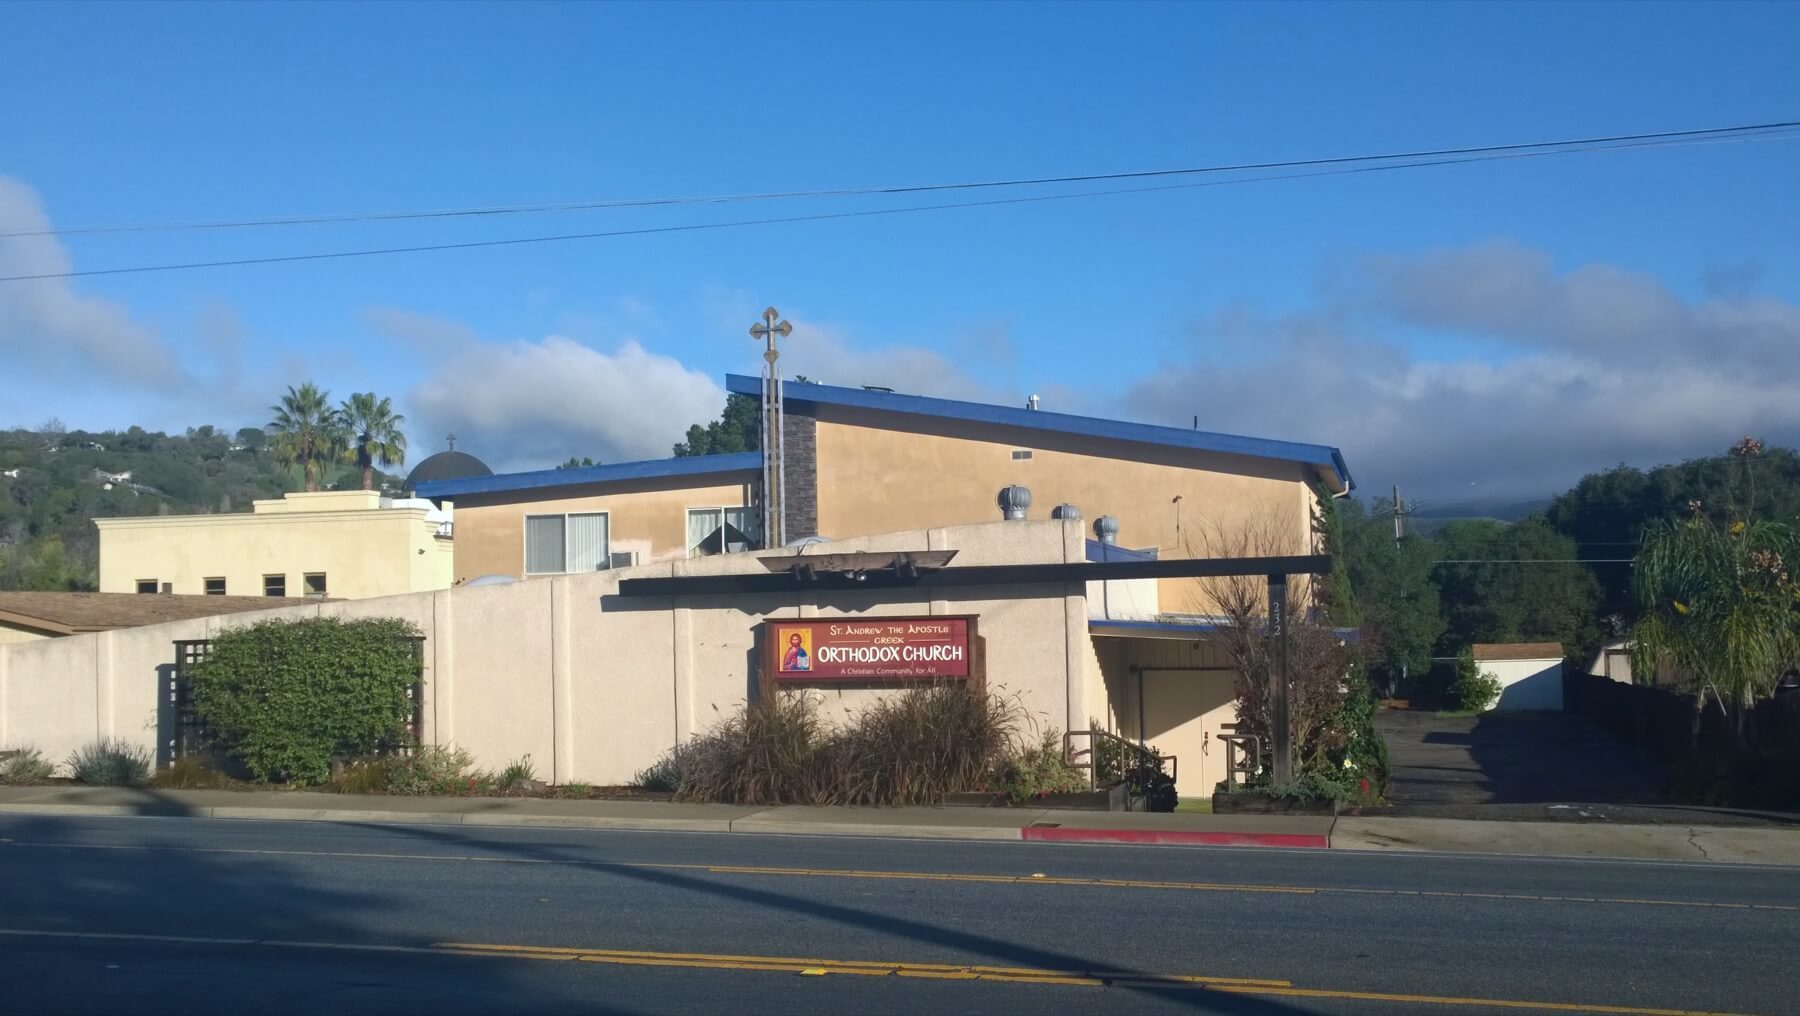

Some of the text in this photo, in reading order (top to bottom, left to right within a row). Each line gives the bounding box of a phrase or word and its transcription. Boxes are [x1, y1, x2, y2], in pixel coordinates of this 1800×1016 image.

[1272, 602, 1281, 636] 232
[874, 636, 905, 645] GREEK
[818, 645, 963, 663] ORTHODOX CHURCH
[915, 667, 926, 675] for
